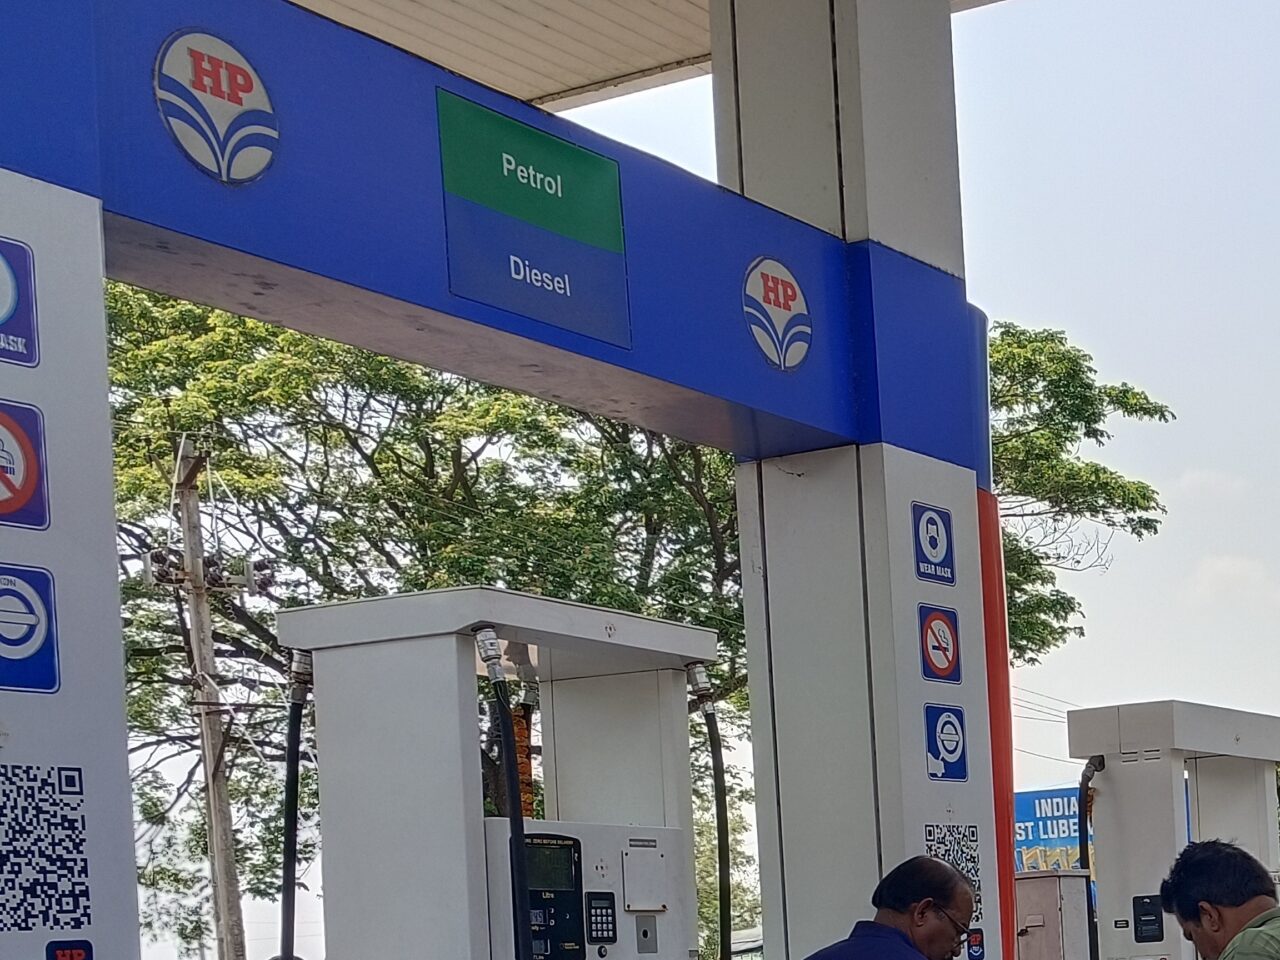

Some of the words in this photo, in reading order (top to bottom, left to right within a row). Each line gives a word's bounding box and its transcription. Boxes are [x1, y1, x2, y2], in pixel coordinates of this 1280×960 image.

[188, 48, 254, 107] HP
[501, 152, 563, 198] Petrol
[509, 254, 571, 297] Diesel
[760, 272, 798, 312] HP
[0, 333, 27, 354] ASK
[919, 562, 935, 575] WEAR
[936, 565, 952, 578] MASK
[1014, 821, 1034, 841] ST
[1038, 818, 1079, 839] LUBE
